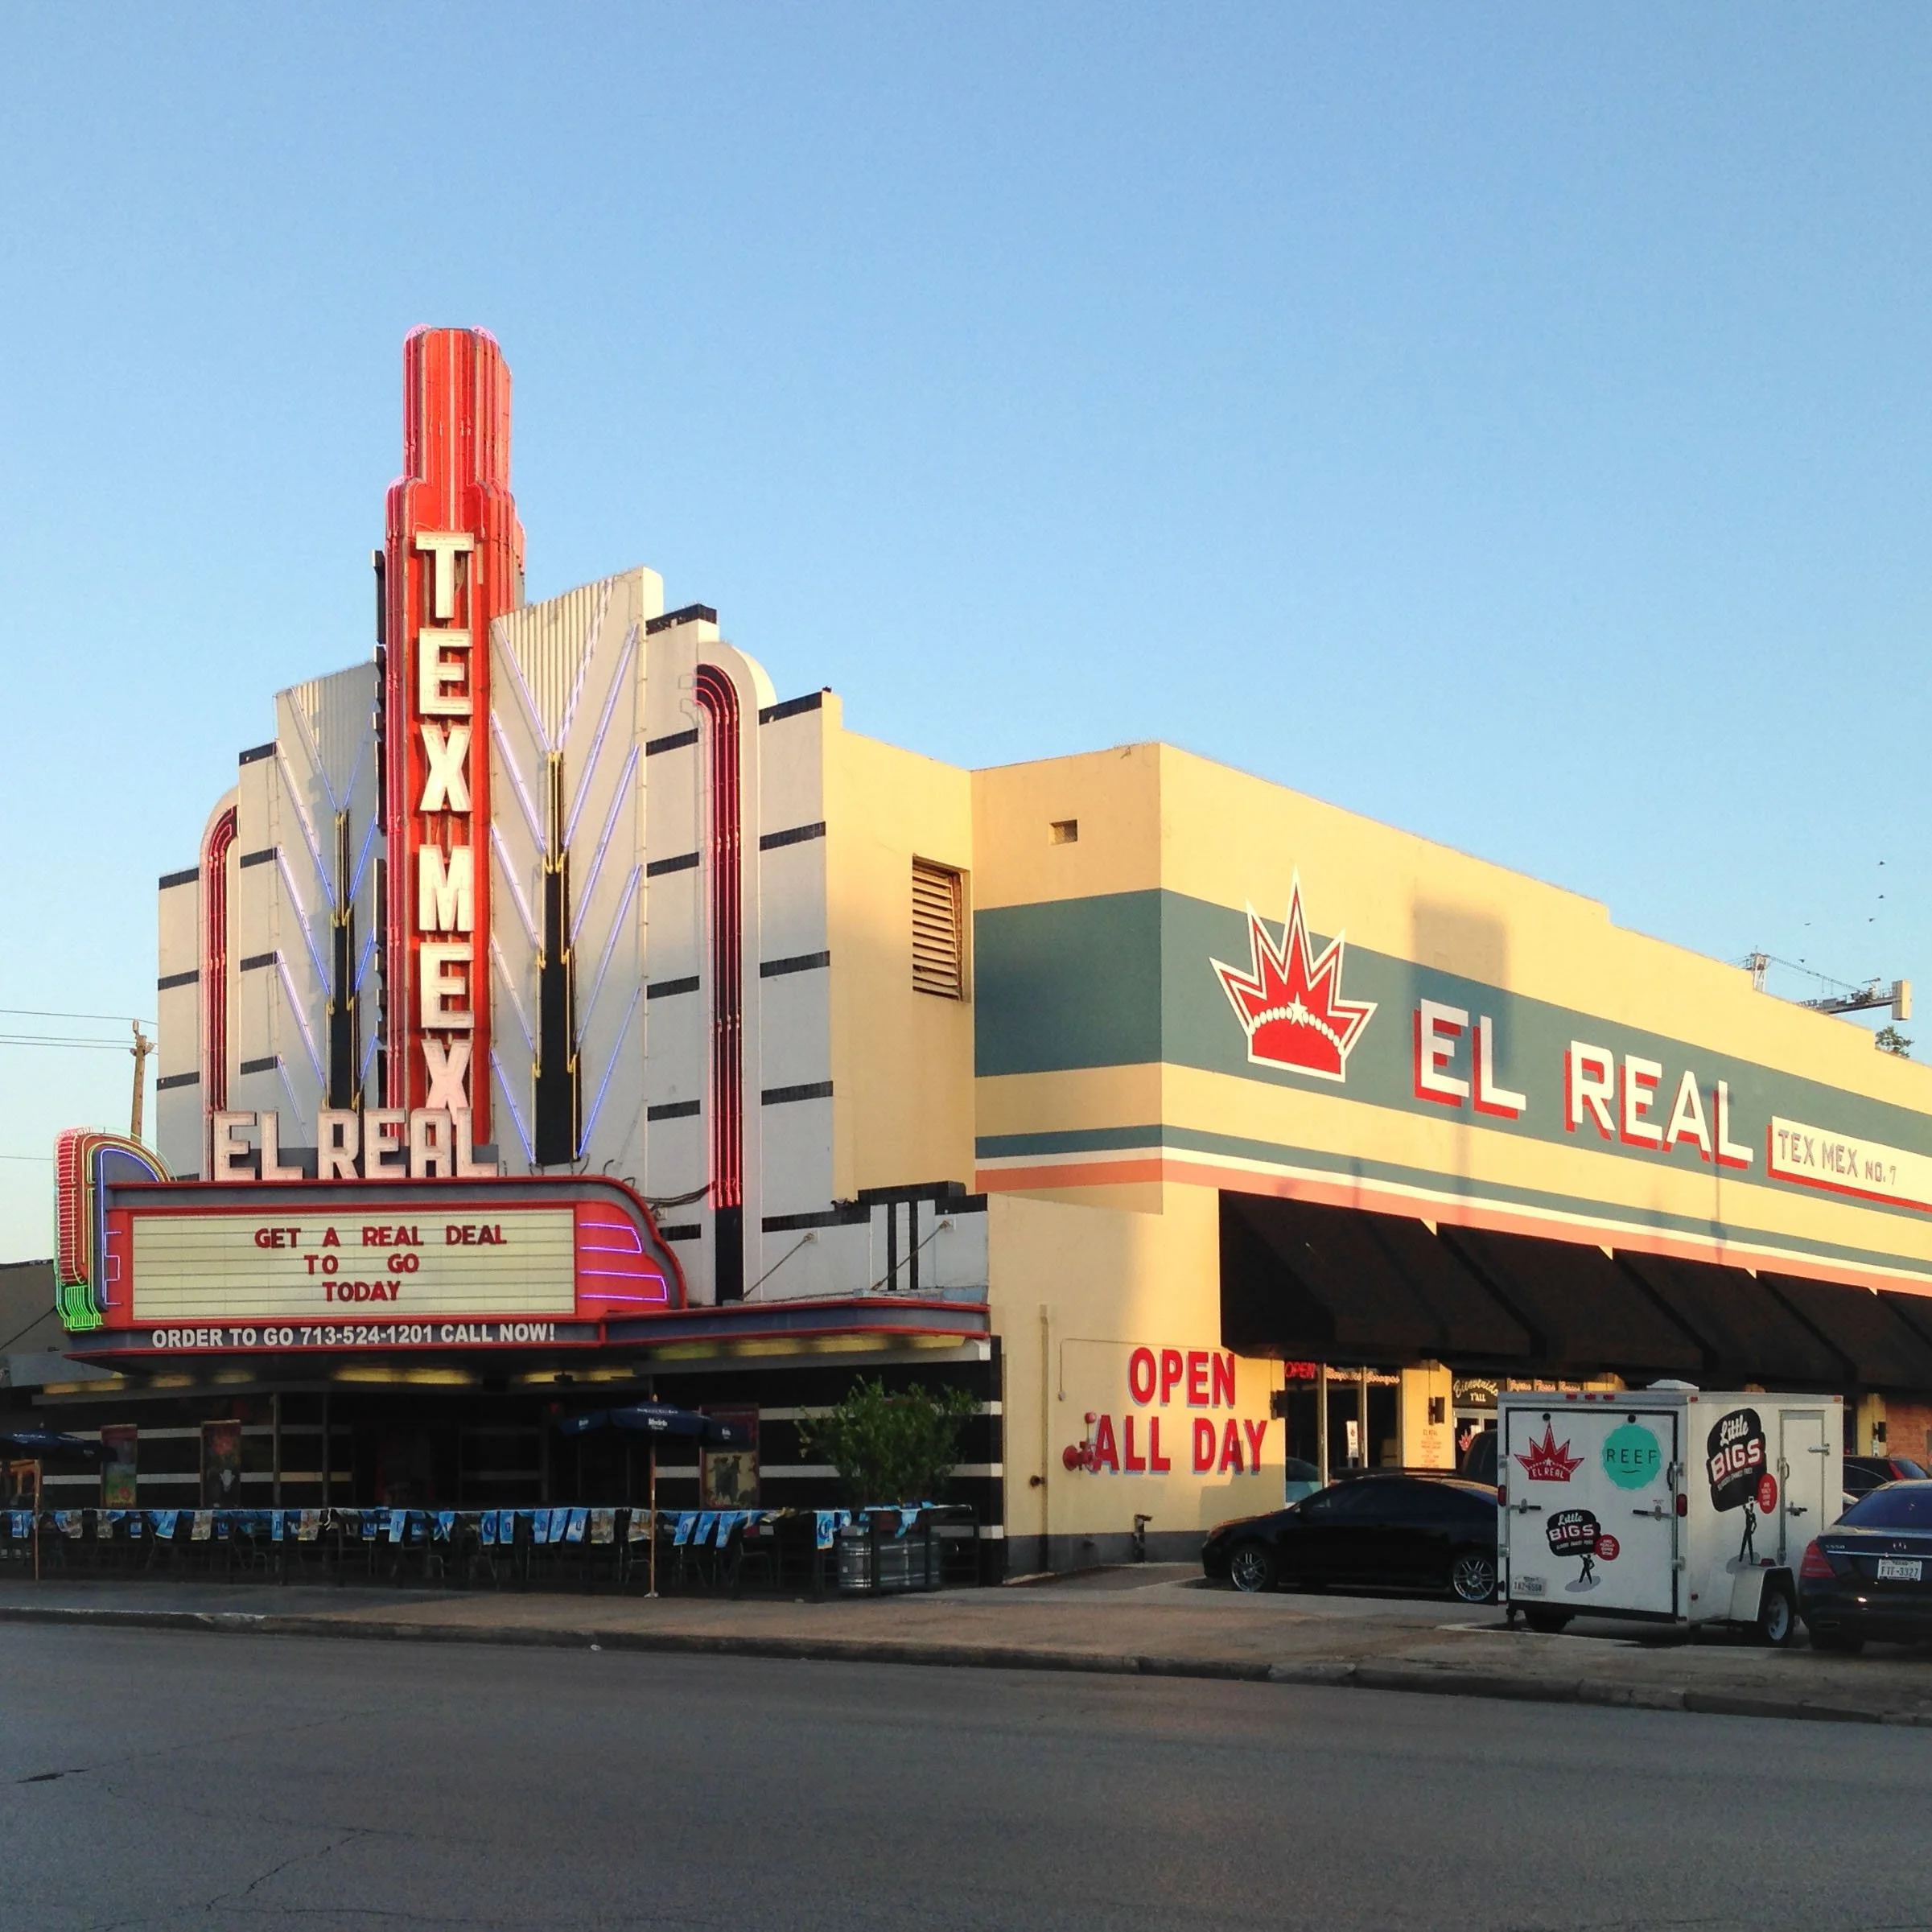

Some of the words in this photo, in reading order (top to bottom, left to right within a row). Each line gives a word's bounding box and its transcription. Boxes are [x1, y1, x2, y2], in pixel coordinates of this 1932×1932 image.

[416, 532, 473, 813] TEX
[418, 845, 475, 1124] MEX
[1414, 999, 1526, 1119] EL
[1564, 1040, 1754, 1171] REAL
[213, 1110, 303, 1181] EL
[318, 1107, 498, 1180] REAL
[1778, 1129, 1815, 1167] TEX
[1822, 1140, 1858, 1177] MEX
[1865, 1159, 1886, 1183] NO.
[254, 1228, 301, 1249] GET
[322, 1227, 340, 1248] A
[362, 1226, 424, 1247] REAL
[445, 1225, 507, 1245] DEAL
[303, 1254, 339, 1275] TO
[387, 1253, 419, 1274] GO
[322, 1280, 401, 1302] TODAY
[151, 1329, 223, 1348] ORDER
[229, 1328, 257, 1347] TO
[262, 1327, 294, 1346] GO
[300, 1324, 433, 1346] 713-524-1201
[440, 1324, 493, 1343] CALL
[499, 1322, 555, 1342] NOW!
[1128, 1347, 1236, 1409] OPEN
[1285, 1360, 1316, 1380] OPEN
[1090, 1414, 1172, 1475] ALL
[1193, 1417, 1268, 1476] DAY
[1720, 1414, 1749, 1447] Little
[1607, 1449, 1658, 1464] REEF
[1710, 1438, 1761, 1481] BIGS
[1532, 1469, 1542, 1478] EL
[1544, 1467, 1564, 1479] REAL
[1549, 1524, 1595, 1541] BIGS
[1558, 1512, 1583, 1526] Little
